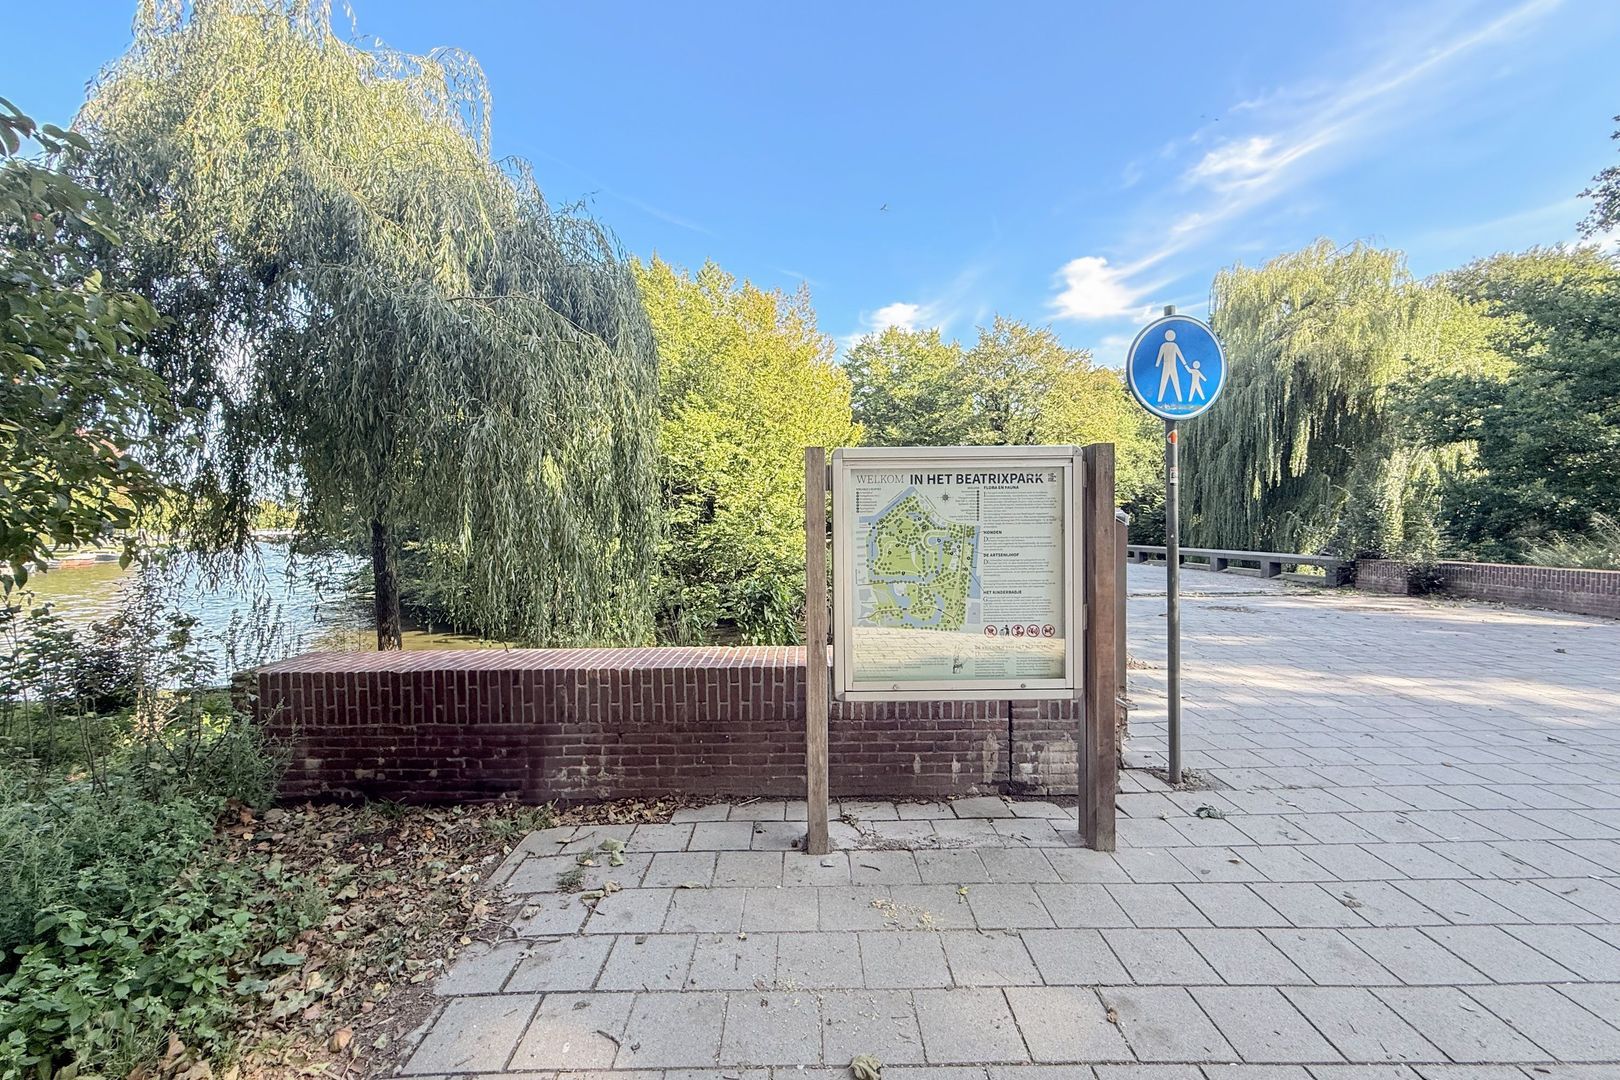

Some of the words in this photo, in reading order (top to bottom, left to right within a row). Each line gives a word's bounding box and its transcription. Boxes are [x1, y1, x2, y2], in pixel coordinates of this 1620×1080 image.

[856, 474, 905, 484] WELKOM
[910, 474, 922, 485] IN
[927, 473, 953, 485] HET
[956, 473, 1044, 485] BEATRIXPARK
